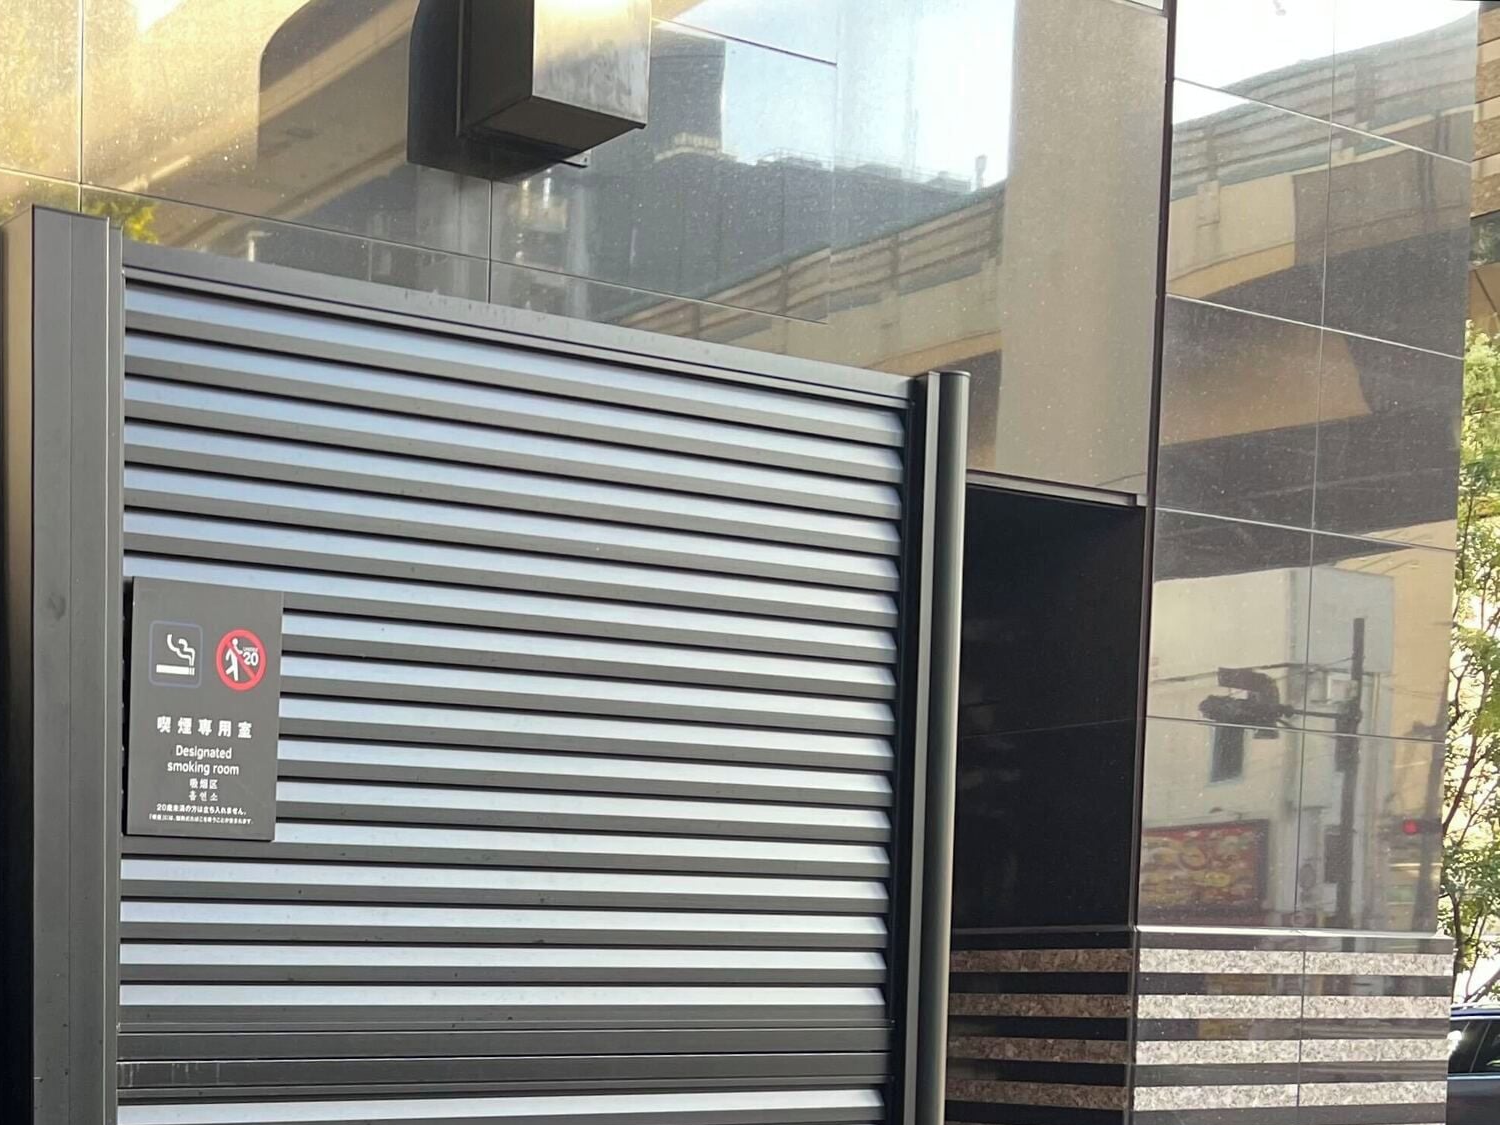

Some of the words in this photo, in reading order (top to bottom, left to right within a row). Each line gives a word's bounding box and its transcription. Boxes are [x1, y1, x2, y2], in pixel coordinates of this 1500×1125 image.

[242, 652, 259, 666] 20
[157, 716, 252, 738] 喫煙専用室
[176, 744, 232, 760] Designated
[167, 760, 210, 776] smoking
[213, 765, 240, 776] room
